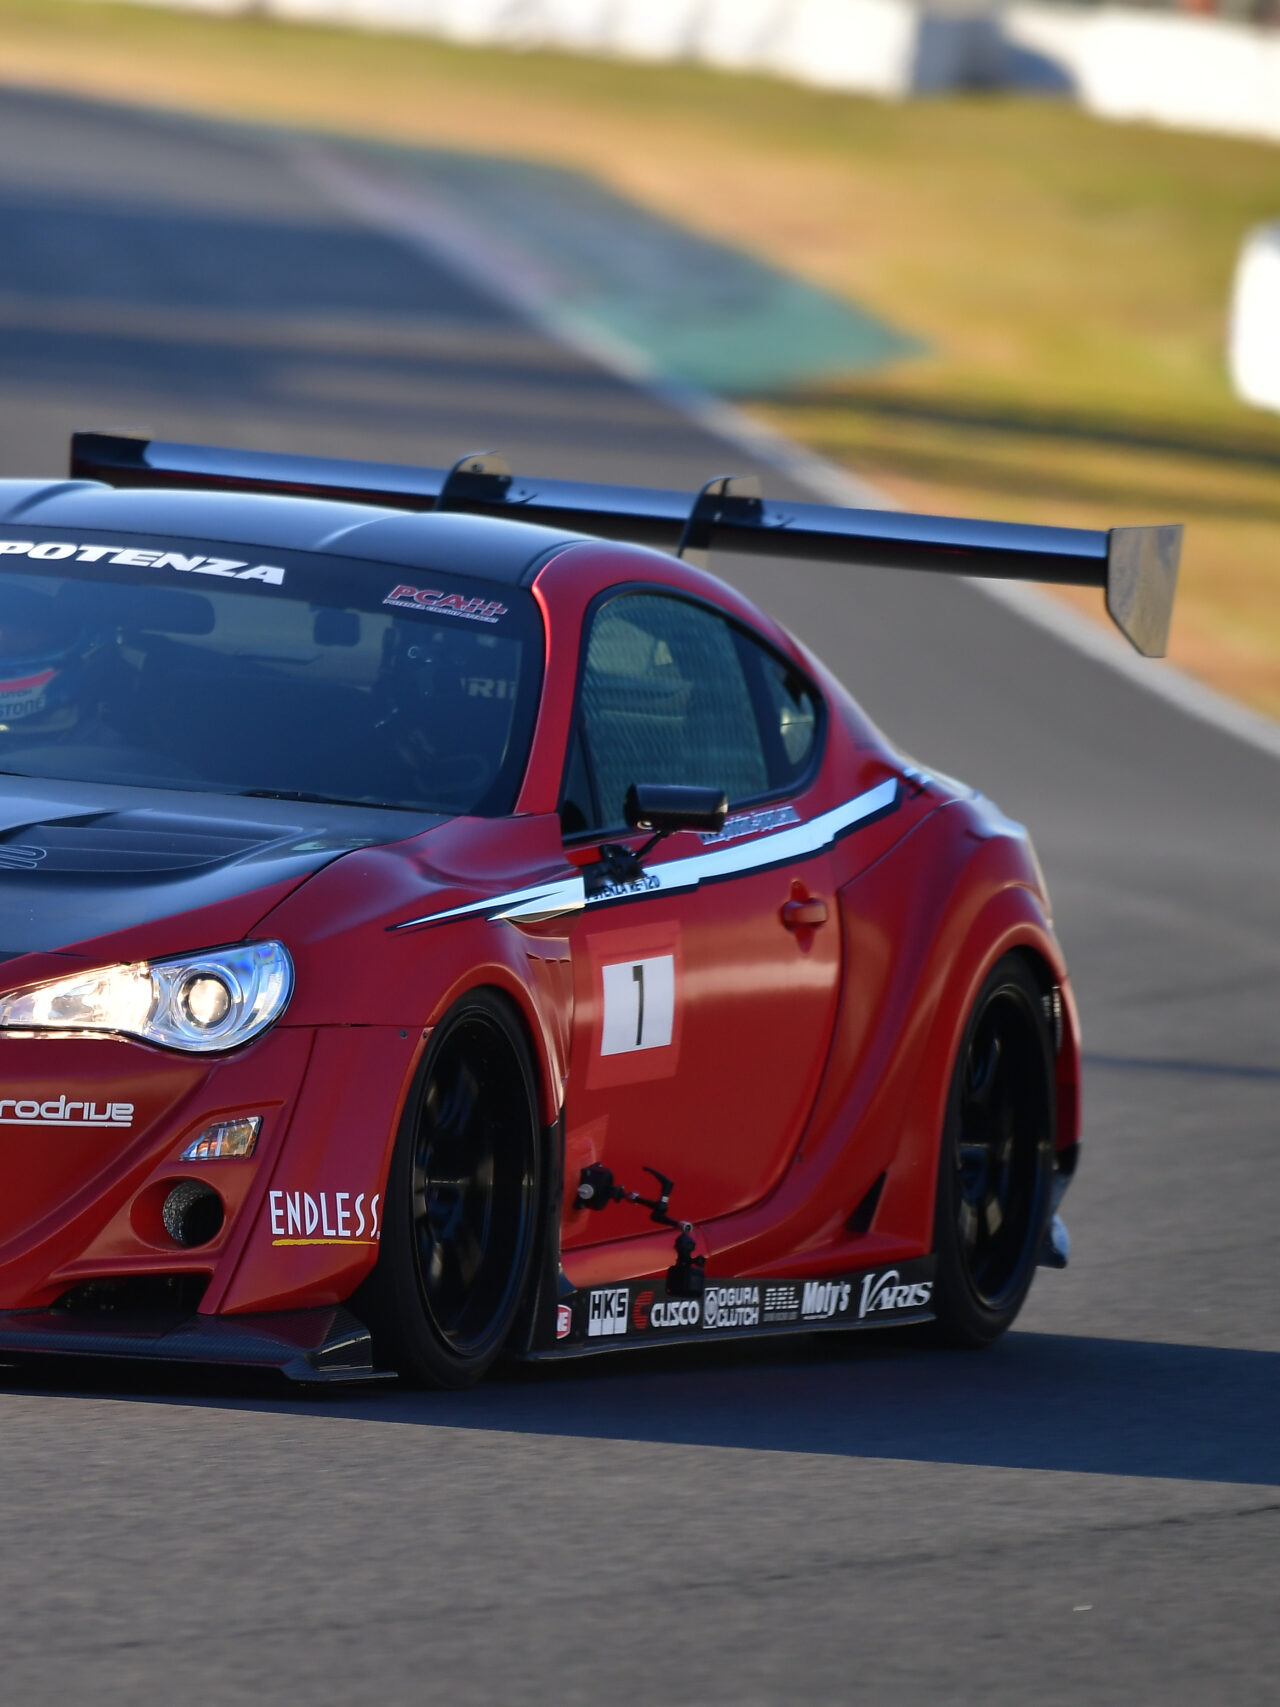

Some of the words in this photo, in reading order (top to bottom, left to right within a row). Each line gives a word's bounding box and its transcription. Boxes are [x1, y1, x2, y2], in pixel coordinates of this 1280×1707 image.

[388, 584, 466, 611] PCA
[632, 964, 644, 1046] 1
[269, 1190, 380, 1238] ENDLESS
[590, 1290, 628, 1323] HKS
[718, 1286, 760, 1307] OGURA
[801, 1281, 851, 1317] Moty's
[650, 1300, 700, 1327] CUSCO
[716, 1307, 760, 1327] CLUTCH
